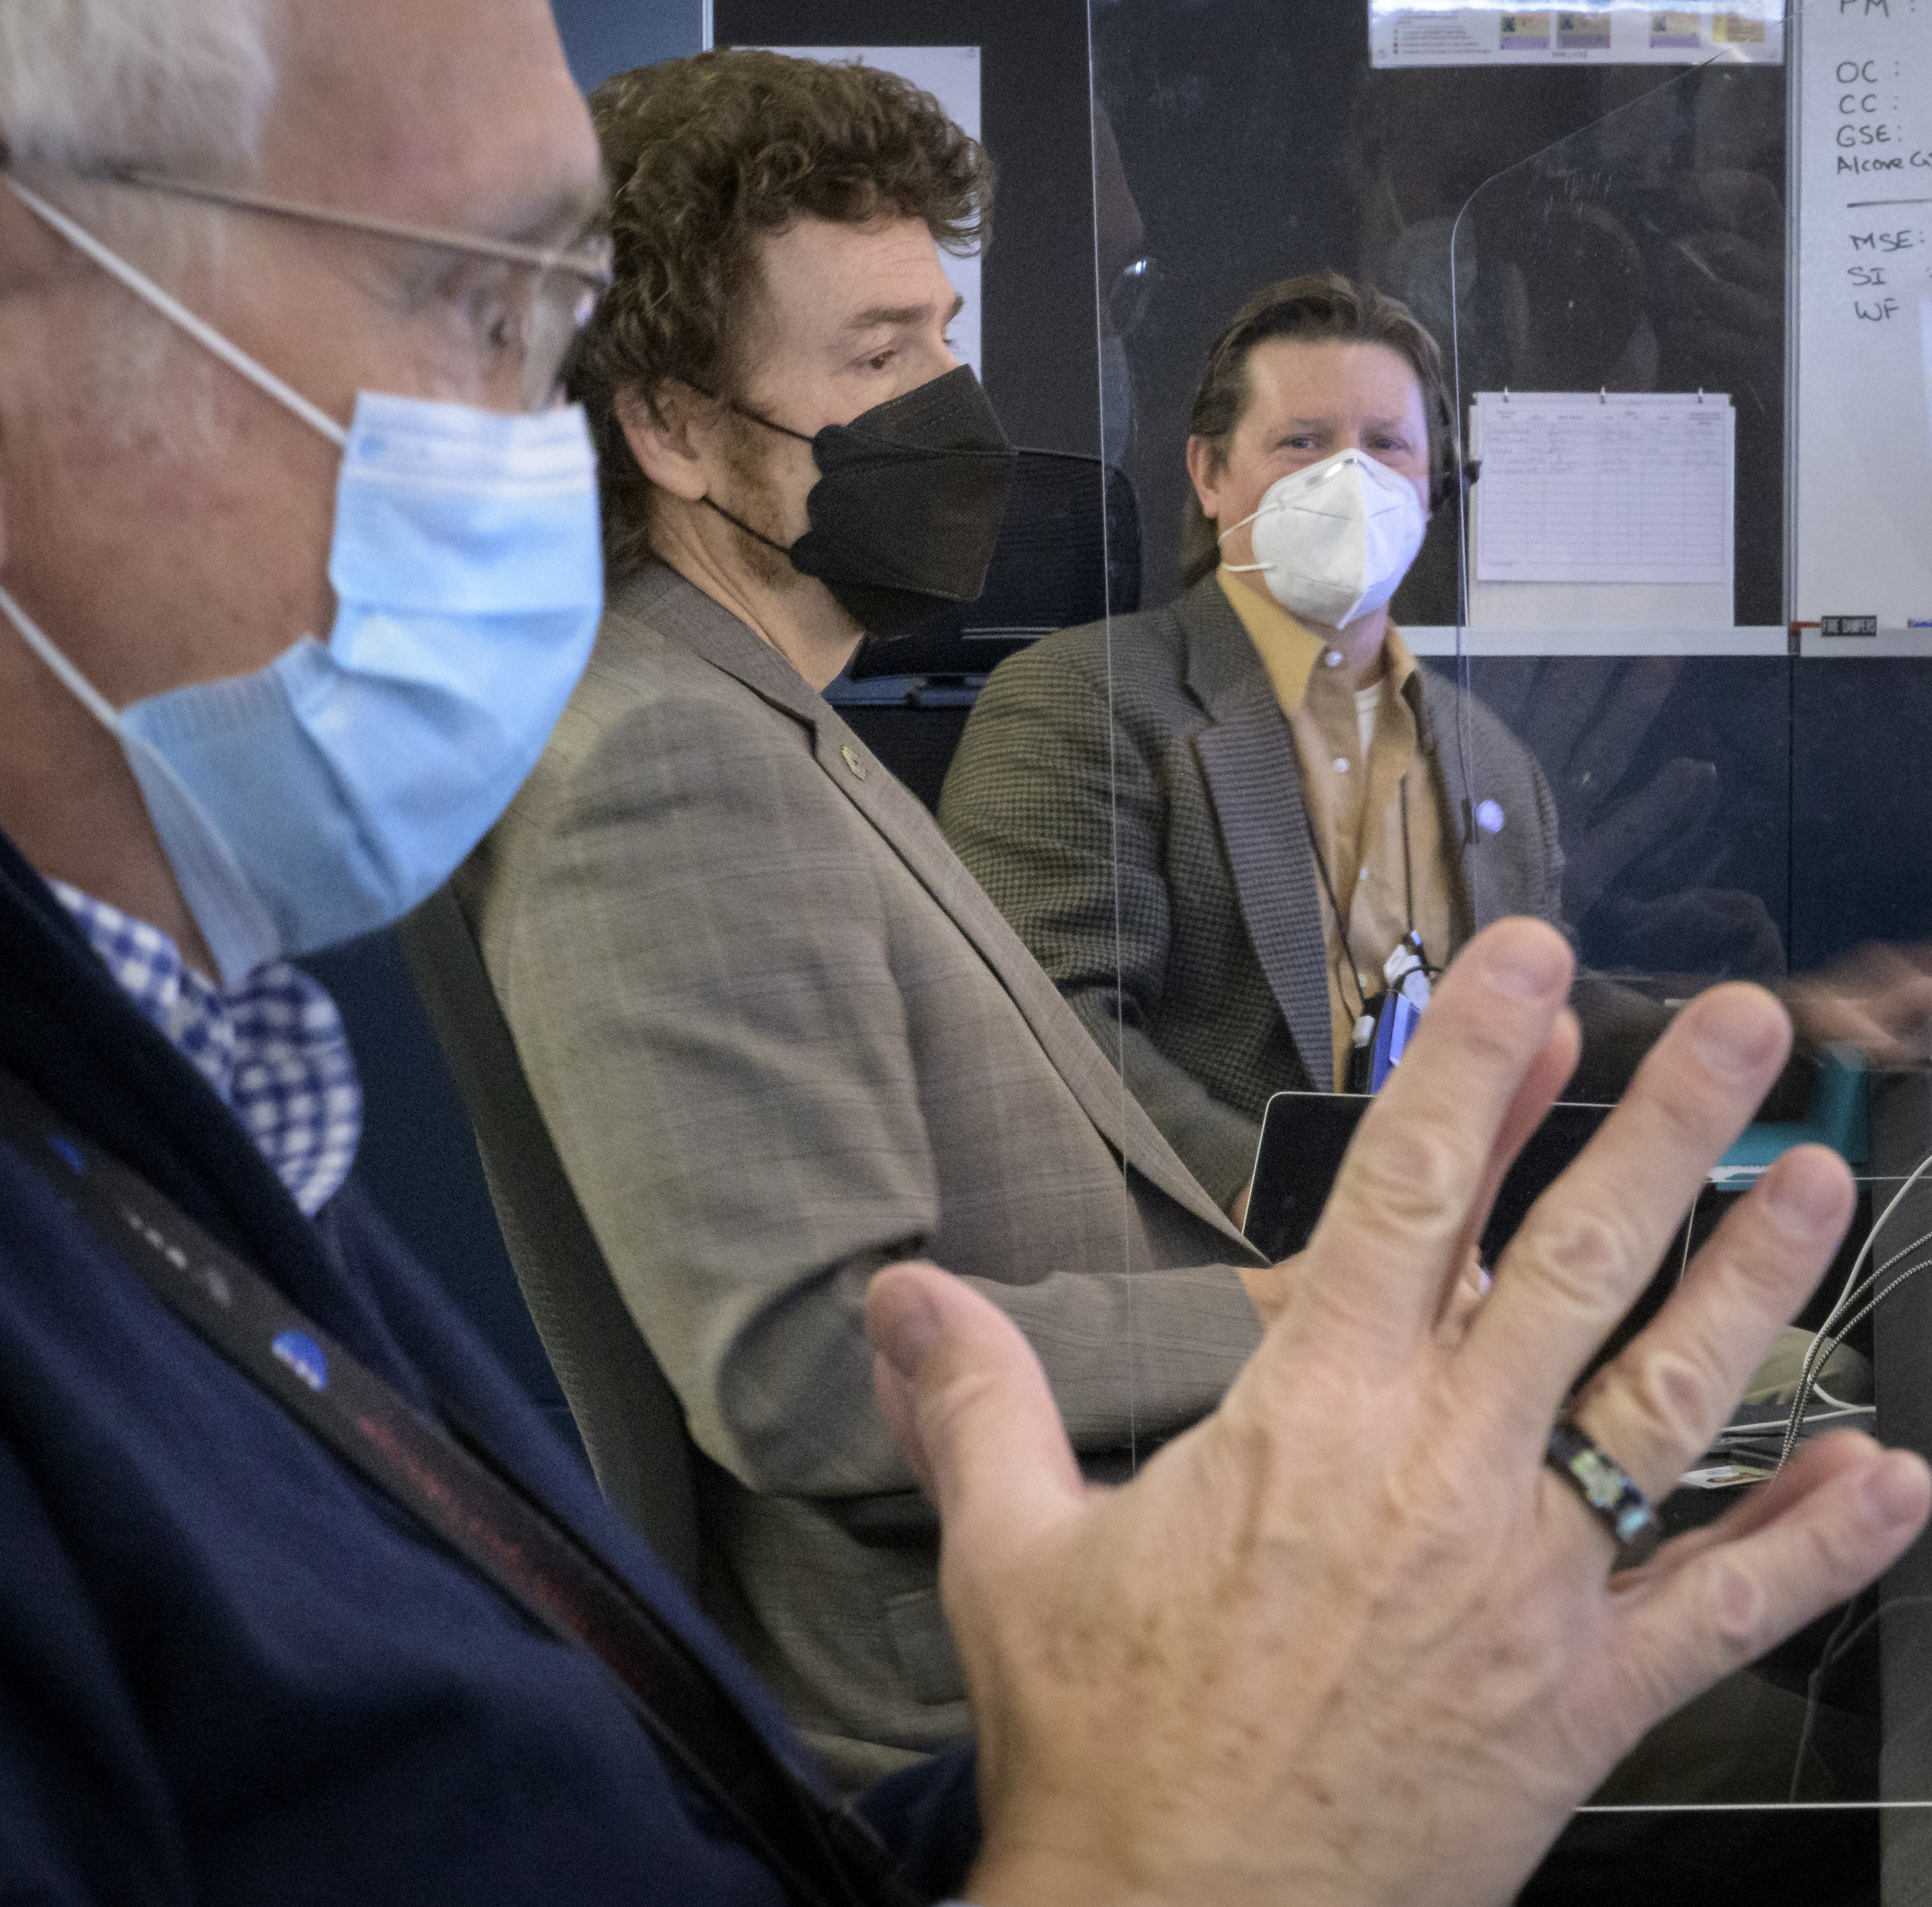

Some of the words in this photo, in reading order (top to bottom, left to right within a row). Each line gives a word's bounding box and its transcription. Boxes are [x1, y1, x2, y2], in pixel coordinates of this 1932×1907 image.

[1836, 60, 1878, 83] OC
[1838, 94, 1877, 113] CC
[1847, 266, 1886, 286] SI
[1854, 297, 1899, 322] WF
